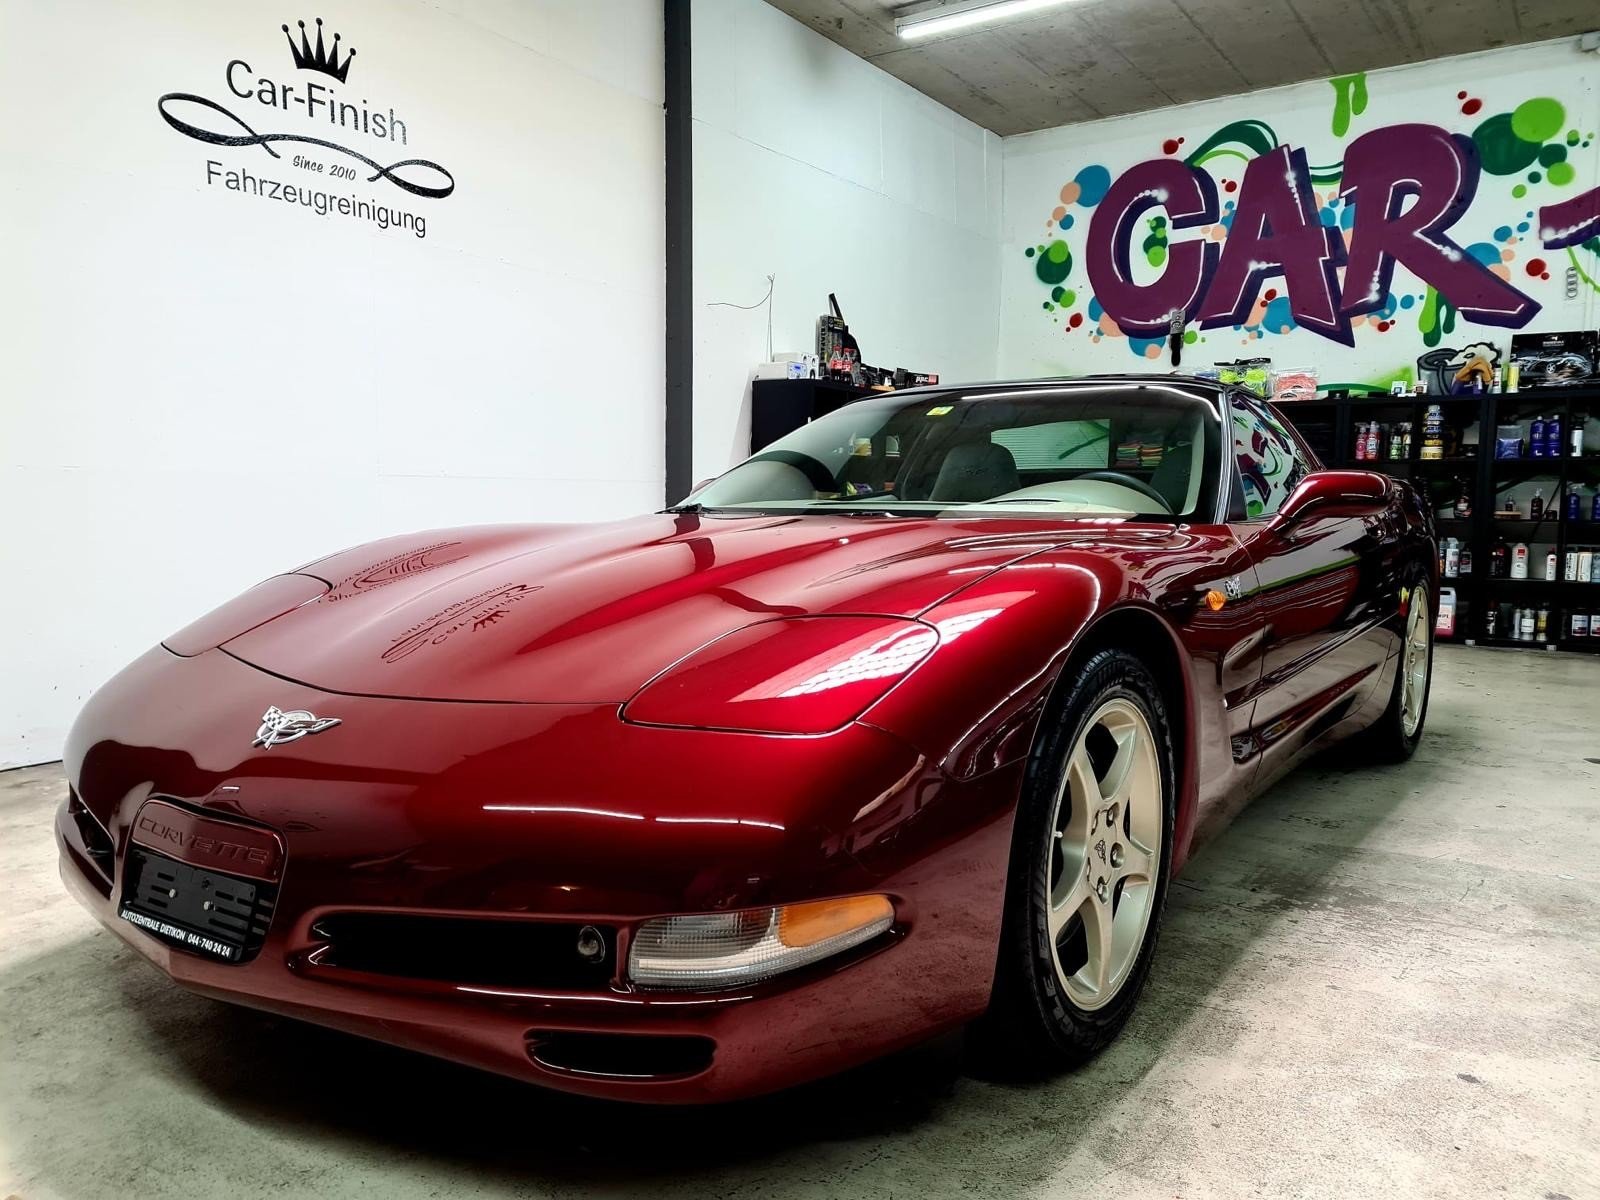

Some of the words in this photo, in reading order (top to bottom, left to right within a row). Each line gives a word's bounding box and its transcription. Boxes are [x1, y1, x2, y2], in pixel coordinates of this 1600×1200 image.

[226, 59, 407, 145] Car-Finish
[206, 159, 426, 239] Fahrzeugreinigung
[329, 163, 356, 181] 2010
[1086, 122, 1543, 348] CAR
[139, 817, 270, 864] CORVETTE
[121, 909, 160, 931] AUTOZENTRALE
[160, 923, 186, 940] DIETIKON
[213, 942, 222, 954] 24
[222, 944, 231, 957] 24
